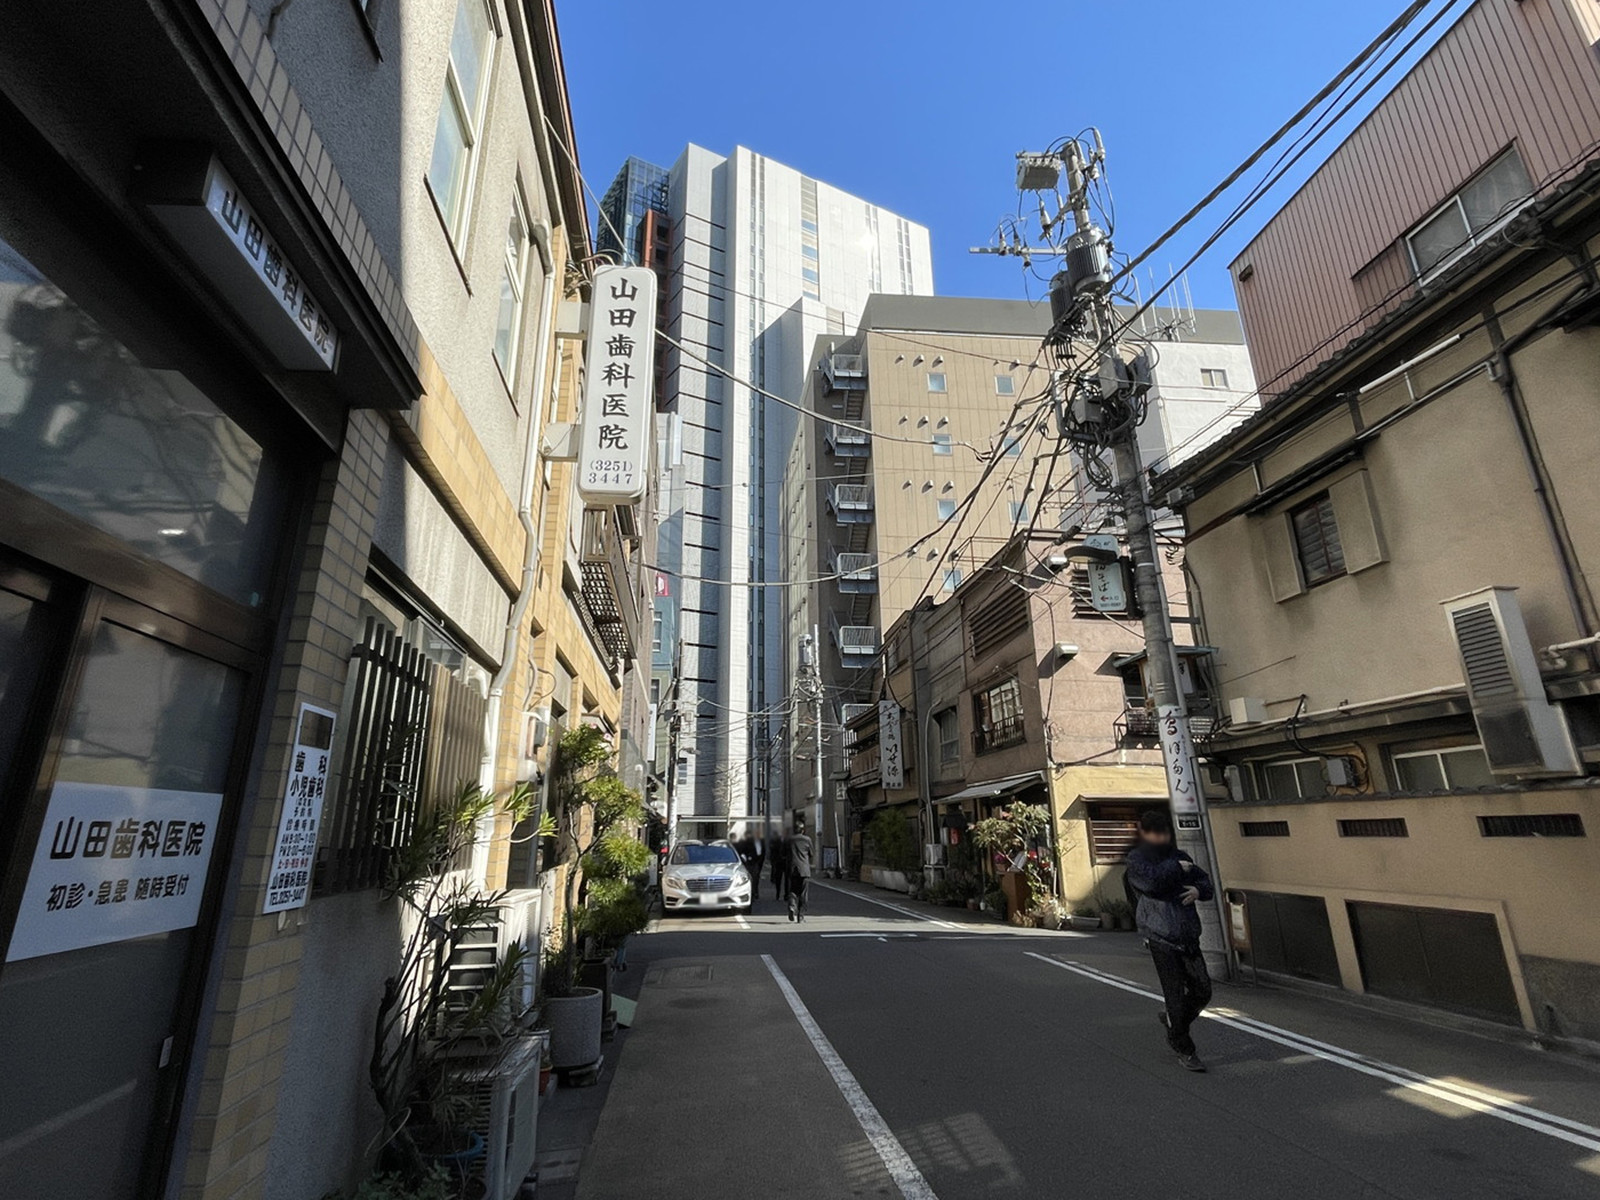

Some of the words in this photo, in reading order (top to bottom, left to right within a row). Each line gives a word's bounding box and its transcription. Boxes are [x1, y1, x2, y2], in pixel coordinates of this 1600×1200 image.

[221, 190, 329, 353] 山田歯科医院
[598, 277, 638, 450] 山田歯科医院
[589, 473, 632, 484] 3447
[590, 460, 633, 472] (3251)
[290, 773, 324, 799] 小児歯科
[50, 816, 206, 859] 山田歯科医院
[46, 879, 130, 912] 初診・急患
[134, 874, 190, 901] 随時受付
[270, 871, 308, 889] 山田歯科医院
